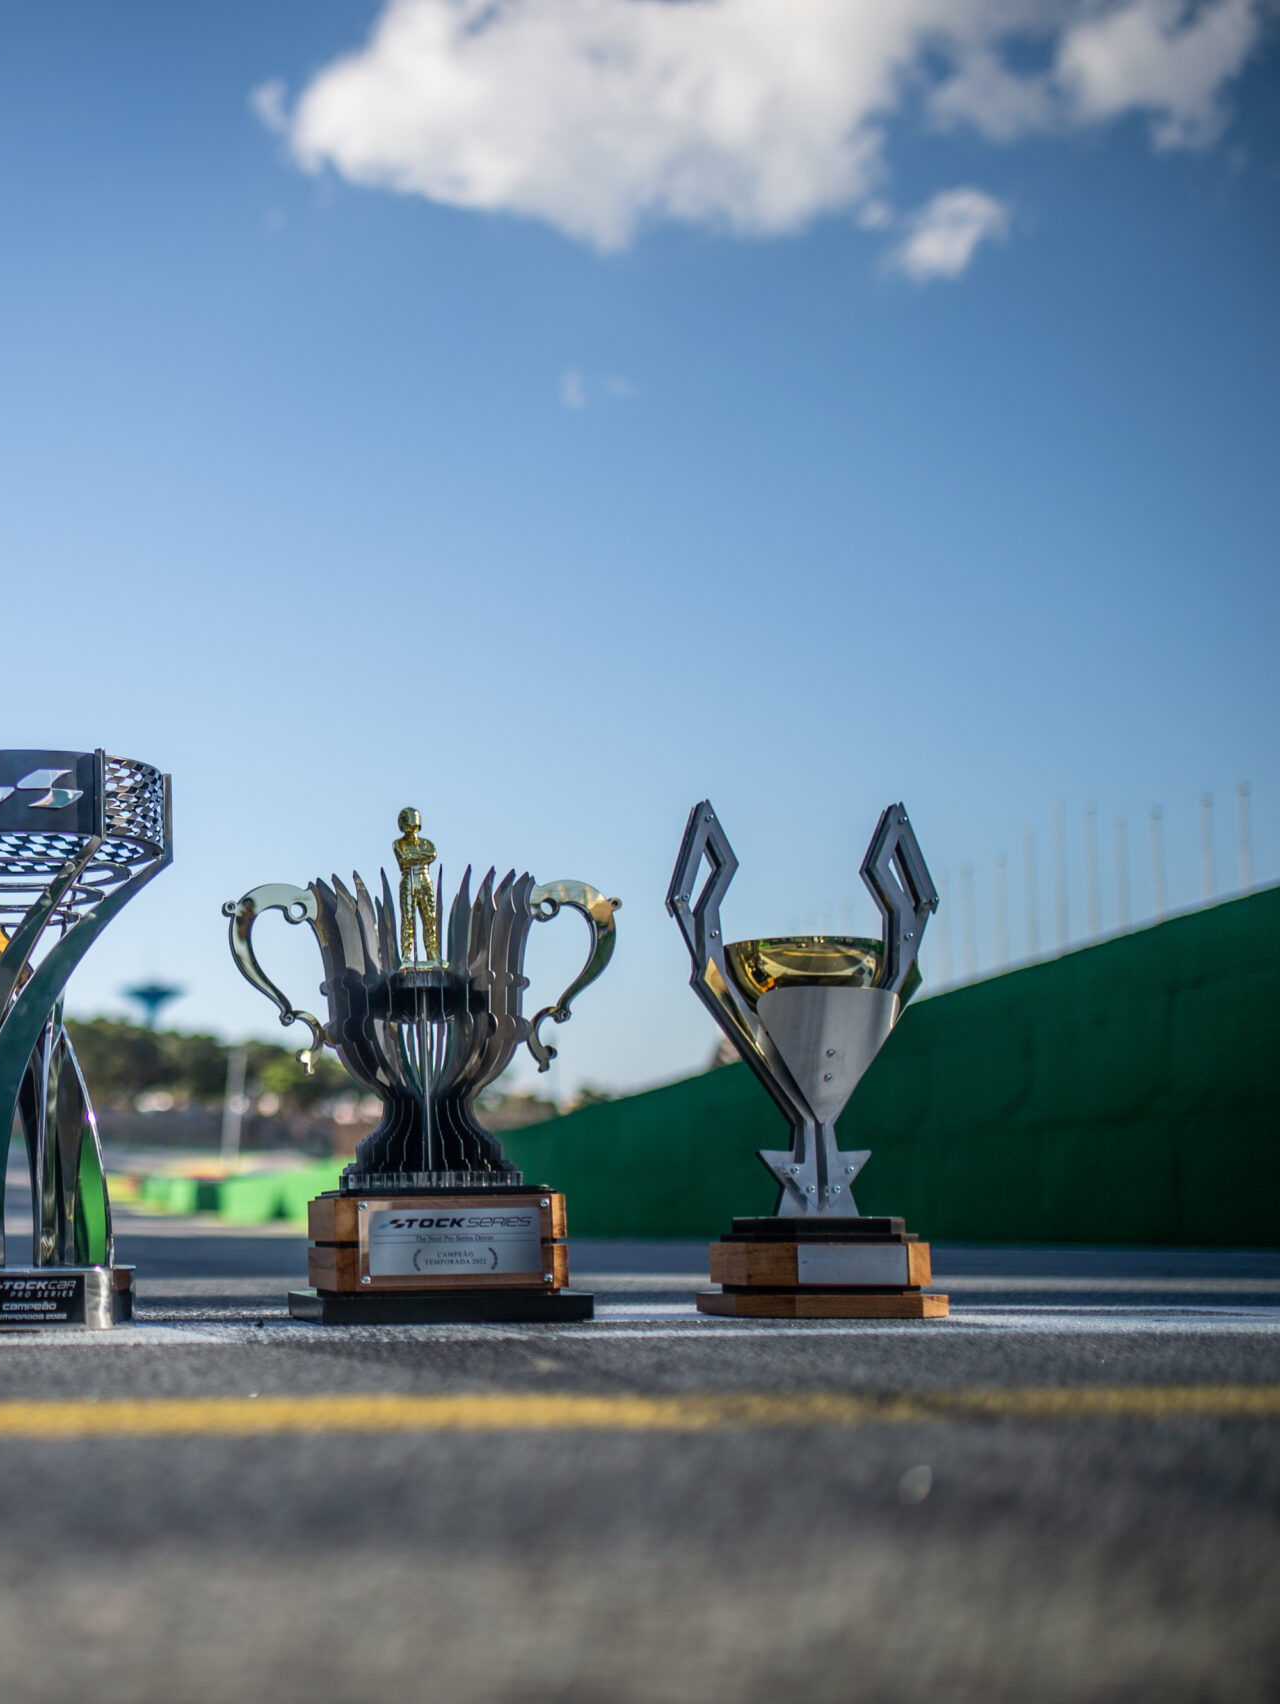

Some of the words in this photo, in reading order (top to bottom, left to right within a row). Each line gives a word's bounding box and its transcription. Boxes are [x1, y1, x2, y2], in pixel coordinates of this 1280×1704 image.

[388, 1217, 465, 1229] STOCK
[436, 1250, 474, 1258] CAMPEÃO
[425, 1258, 471, 1266] TEMPORADA
[10, 1290, 31, 1298] PRO
[37, 1290, 74, 1298] SERIES
